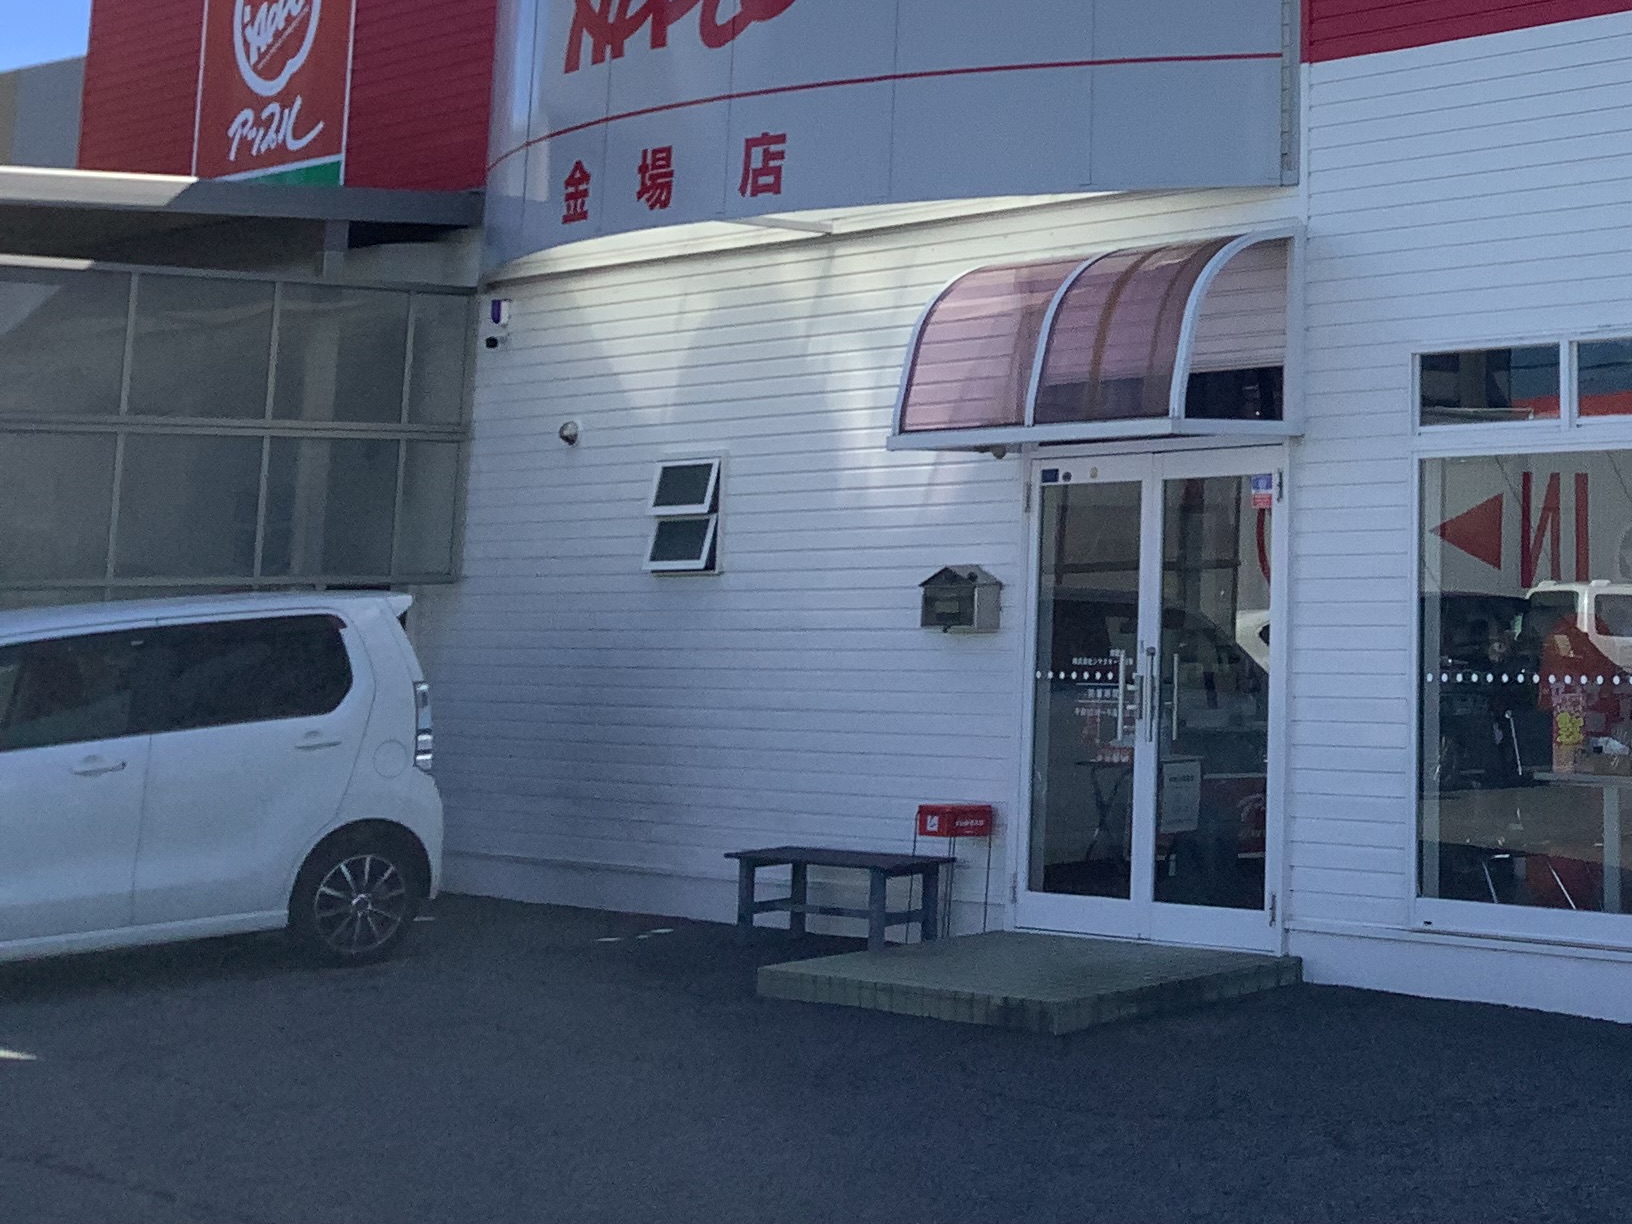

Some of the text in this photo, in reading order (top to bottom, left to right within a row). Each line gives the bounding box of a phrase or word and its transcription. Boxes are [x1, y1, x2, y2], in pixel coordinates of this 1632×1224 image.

[228, 95, 325, 162] アップル
[561, 132, 787, 225] 金場店
